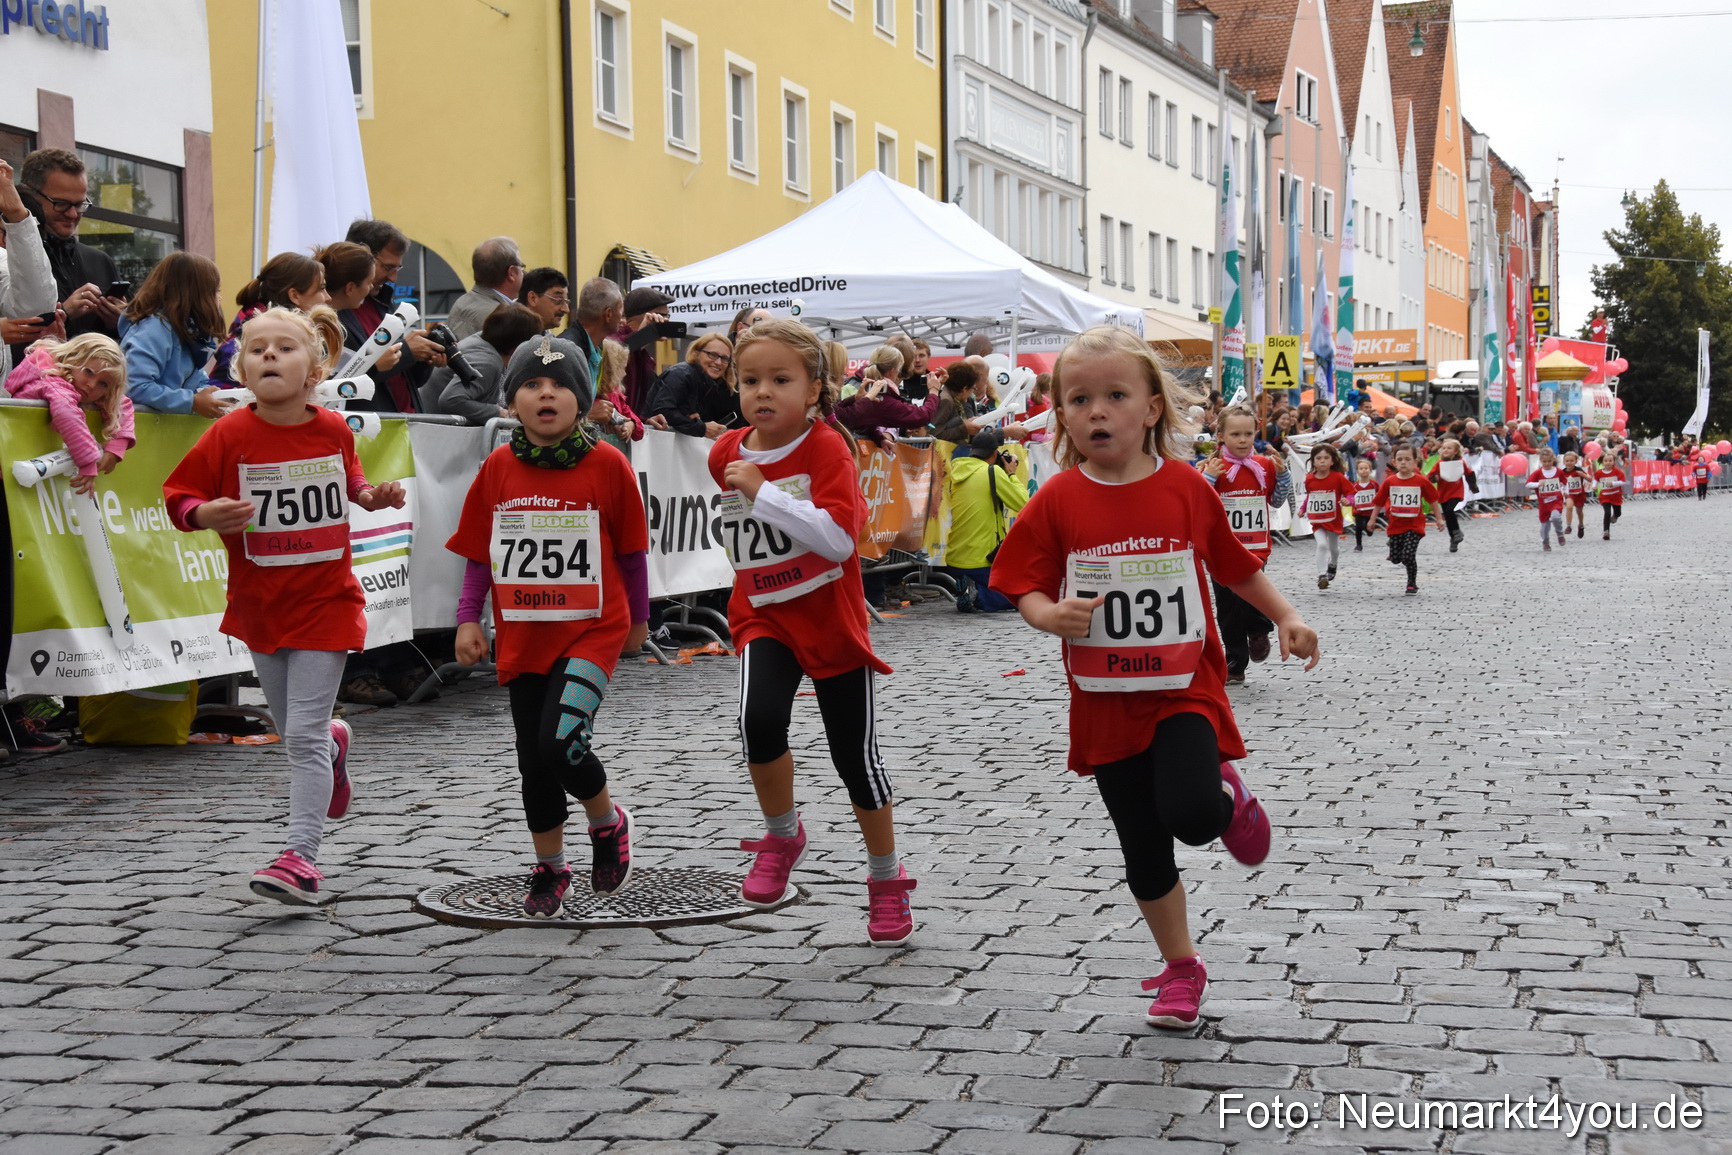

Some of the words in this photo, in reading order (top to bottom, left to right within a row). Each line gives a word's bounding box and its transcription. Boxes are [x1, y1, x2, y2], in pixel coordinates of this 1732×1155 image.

[704, 276, 848, 298] ConnectedDrive
[668, 303, 707, 314] netzt,
[710, 303, 729, 312] um
[731, 299, 752, 311] frei
[754, 299, 769, 310] zu
[1268, 337, 1296, 348] Block
[1271, 352, 1291, 377] A
[288, 459, 339, 477] BOCK
[1568, 481, 1580, 489] 139
[35, 477, 125, 535] Nee
[251, 481, 343, 526] 7500
[1309, 499, 1334, 512] 7053
[1393, 494, 1418, 505] 7134
[532, 515, 589, 528] BOCK
[269, 536, 314, 552] Adela
[724, 518, 793, 563] 720
[500, 538, 590, 579] 7254
[1121, 557, 1185, 577] BOCK
[360, 563, 410, 593] euerM
[752, 566, 803, 591] Emma
[1074, 571, 1112, 580] NeuerMarkt
[514, 589, 566, 610] Sophia
[1107, 653, 1162, 673] Paula
